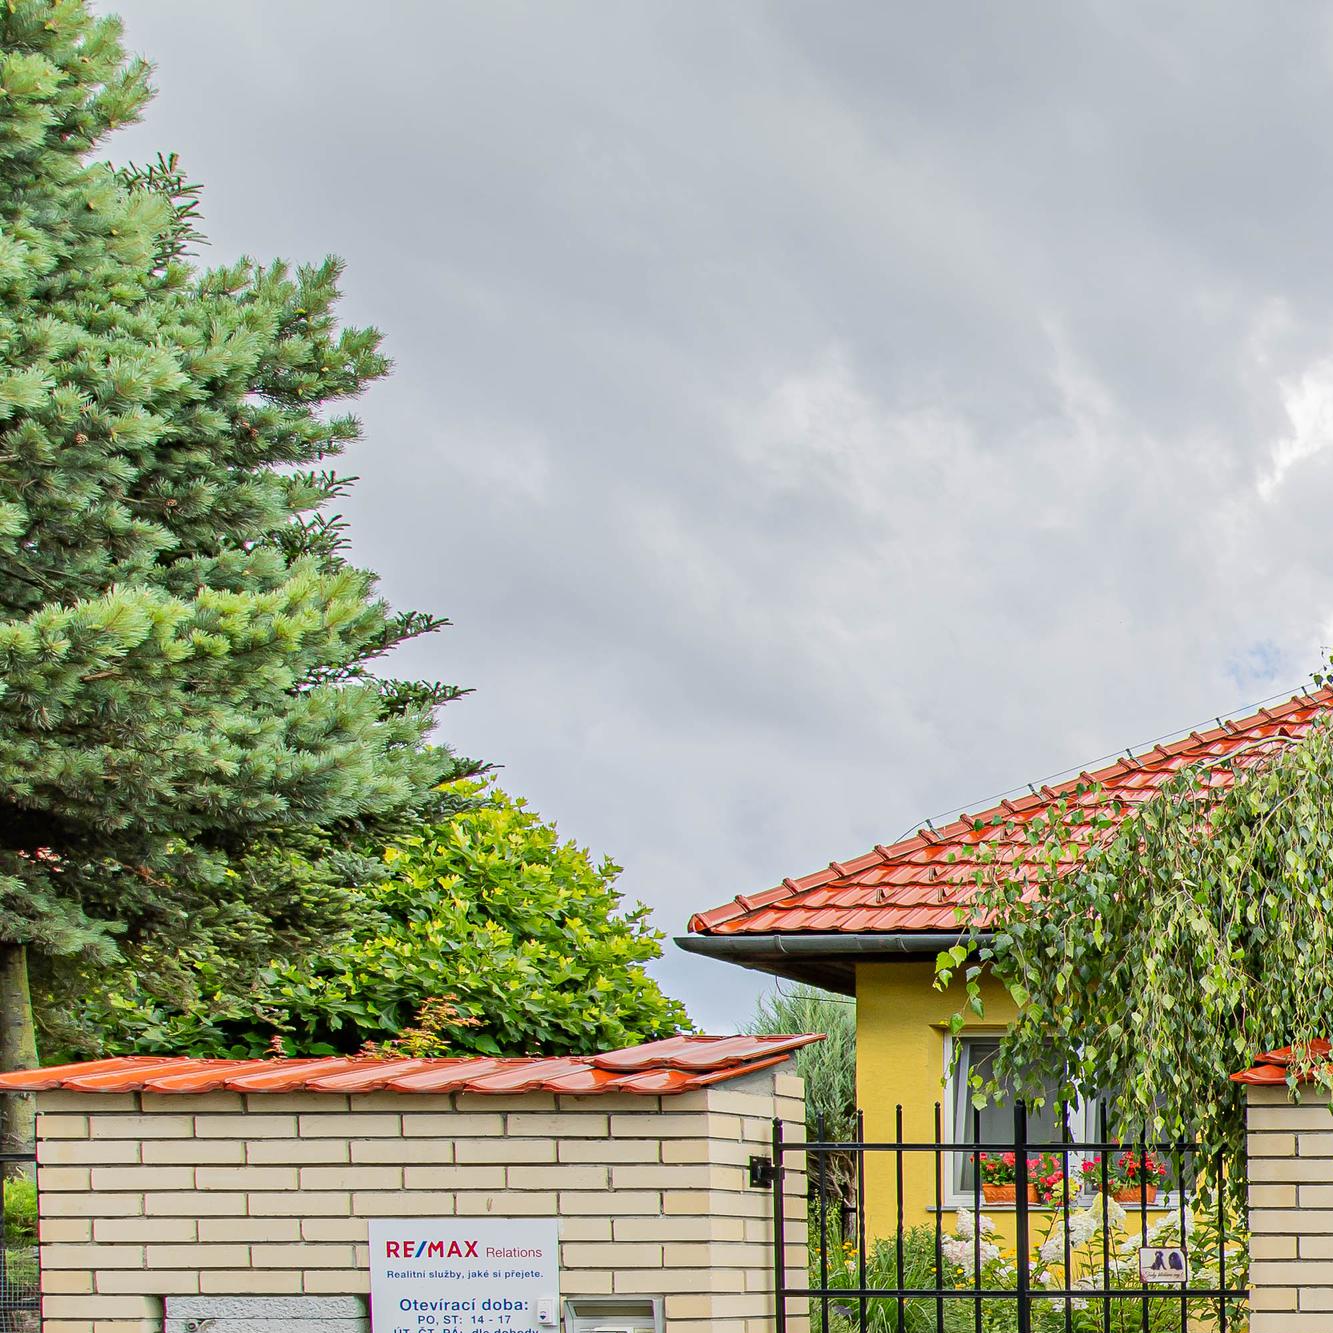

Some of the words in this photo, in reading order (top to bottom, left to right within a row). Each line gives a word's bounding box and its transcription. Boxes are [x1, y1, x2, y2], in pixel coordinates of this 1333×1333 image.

[385, 1240, 479, 1258] RE/MAX
[486, 1247, 543, 1258] Relations
[386, 1269, 426, 1279] Realitní
[429, 1269, 464, 1280] služby,
[467, 1269, 489, 1280] jaké
[493, 1269, 501, 1278] si
[504, 1269, 544, 1280] přejete.
[399, 1298, 476, 1311] Otevírací
[481, 1298, 529, 1311] doba:
[417, 1315, 439, 1325] PO,
[443, 1315, 462, 1325] ST:
[471, 1315, 484, 1324] 14
[498, 1315, 511, 1324] 17
